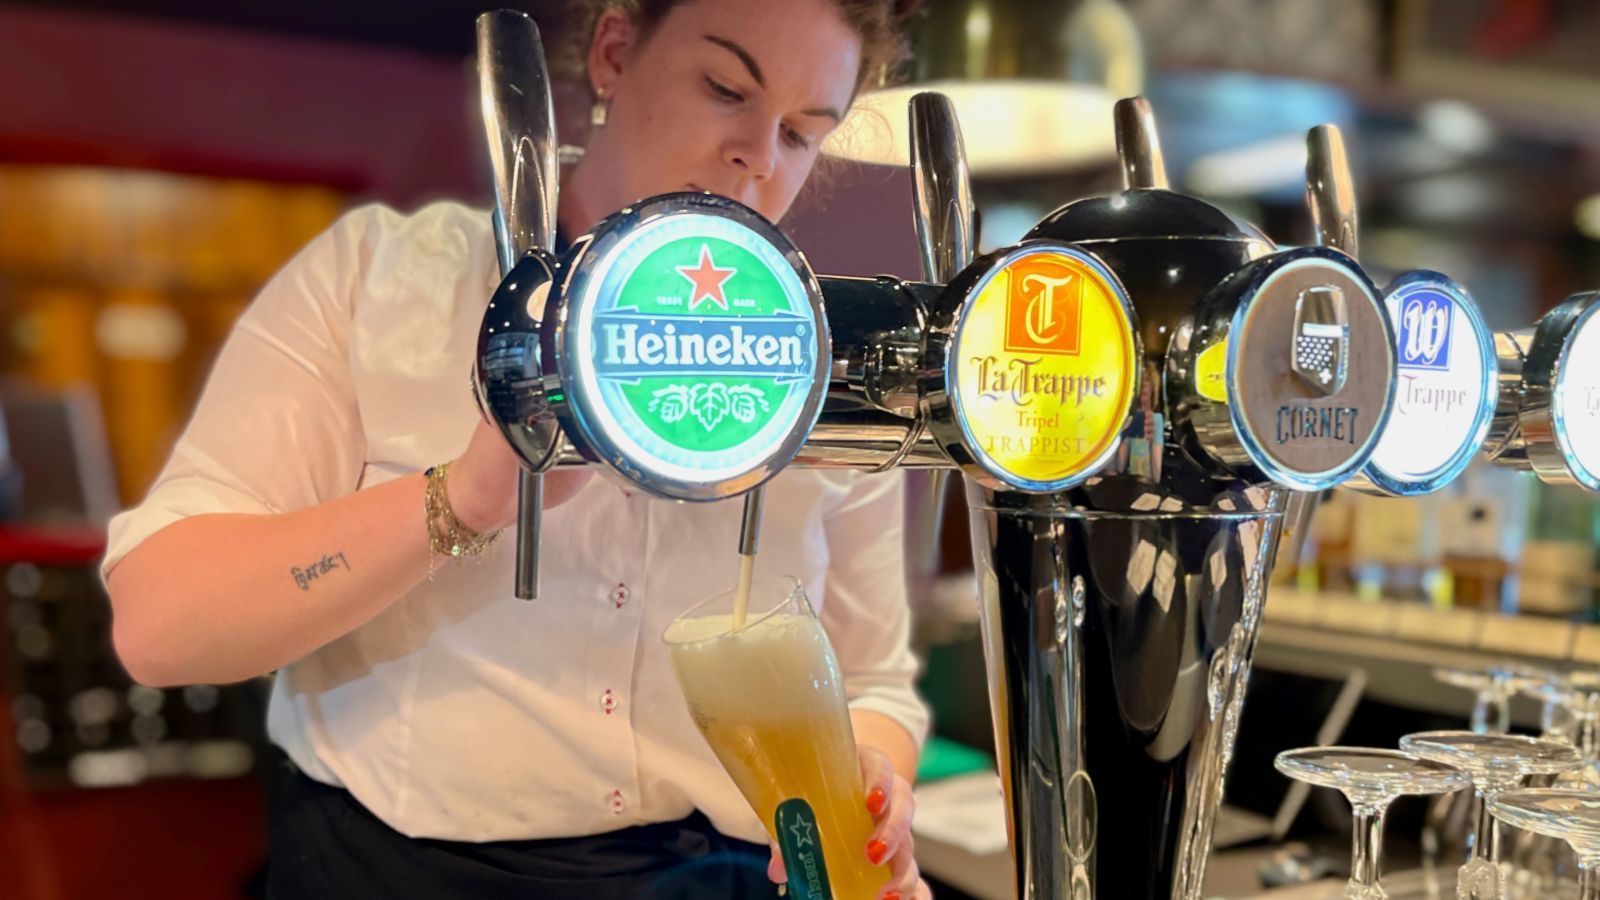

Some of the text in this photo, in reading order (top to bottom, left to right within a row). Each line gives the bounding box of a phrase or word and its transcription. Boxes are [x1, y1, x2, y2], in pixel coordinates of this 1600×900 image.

[602, 323, 803, 366] Heineken
[1016, 411, 1060, 433] Tripel
[1276, 406, 1358, 445] CORNET
[986, 435, 1086, 454] TRAPPIST
